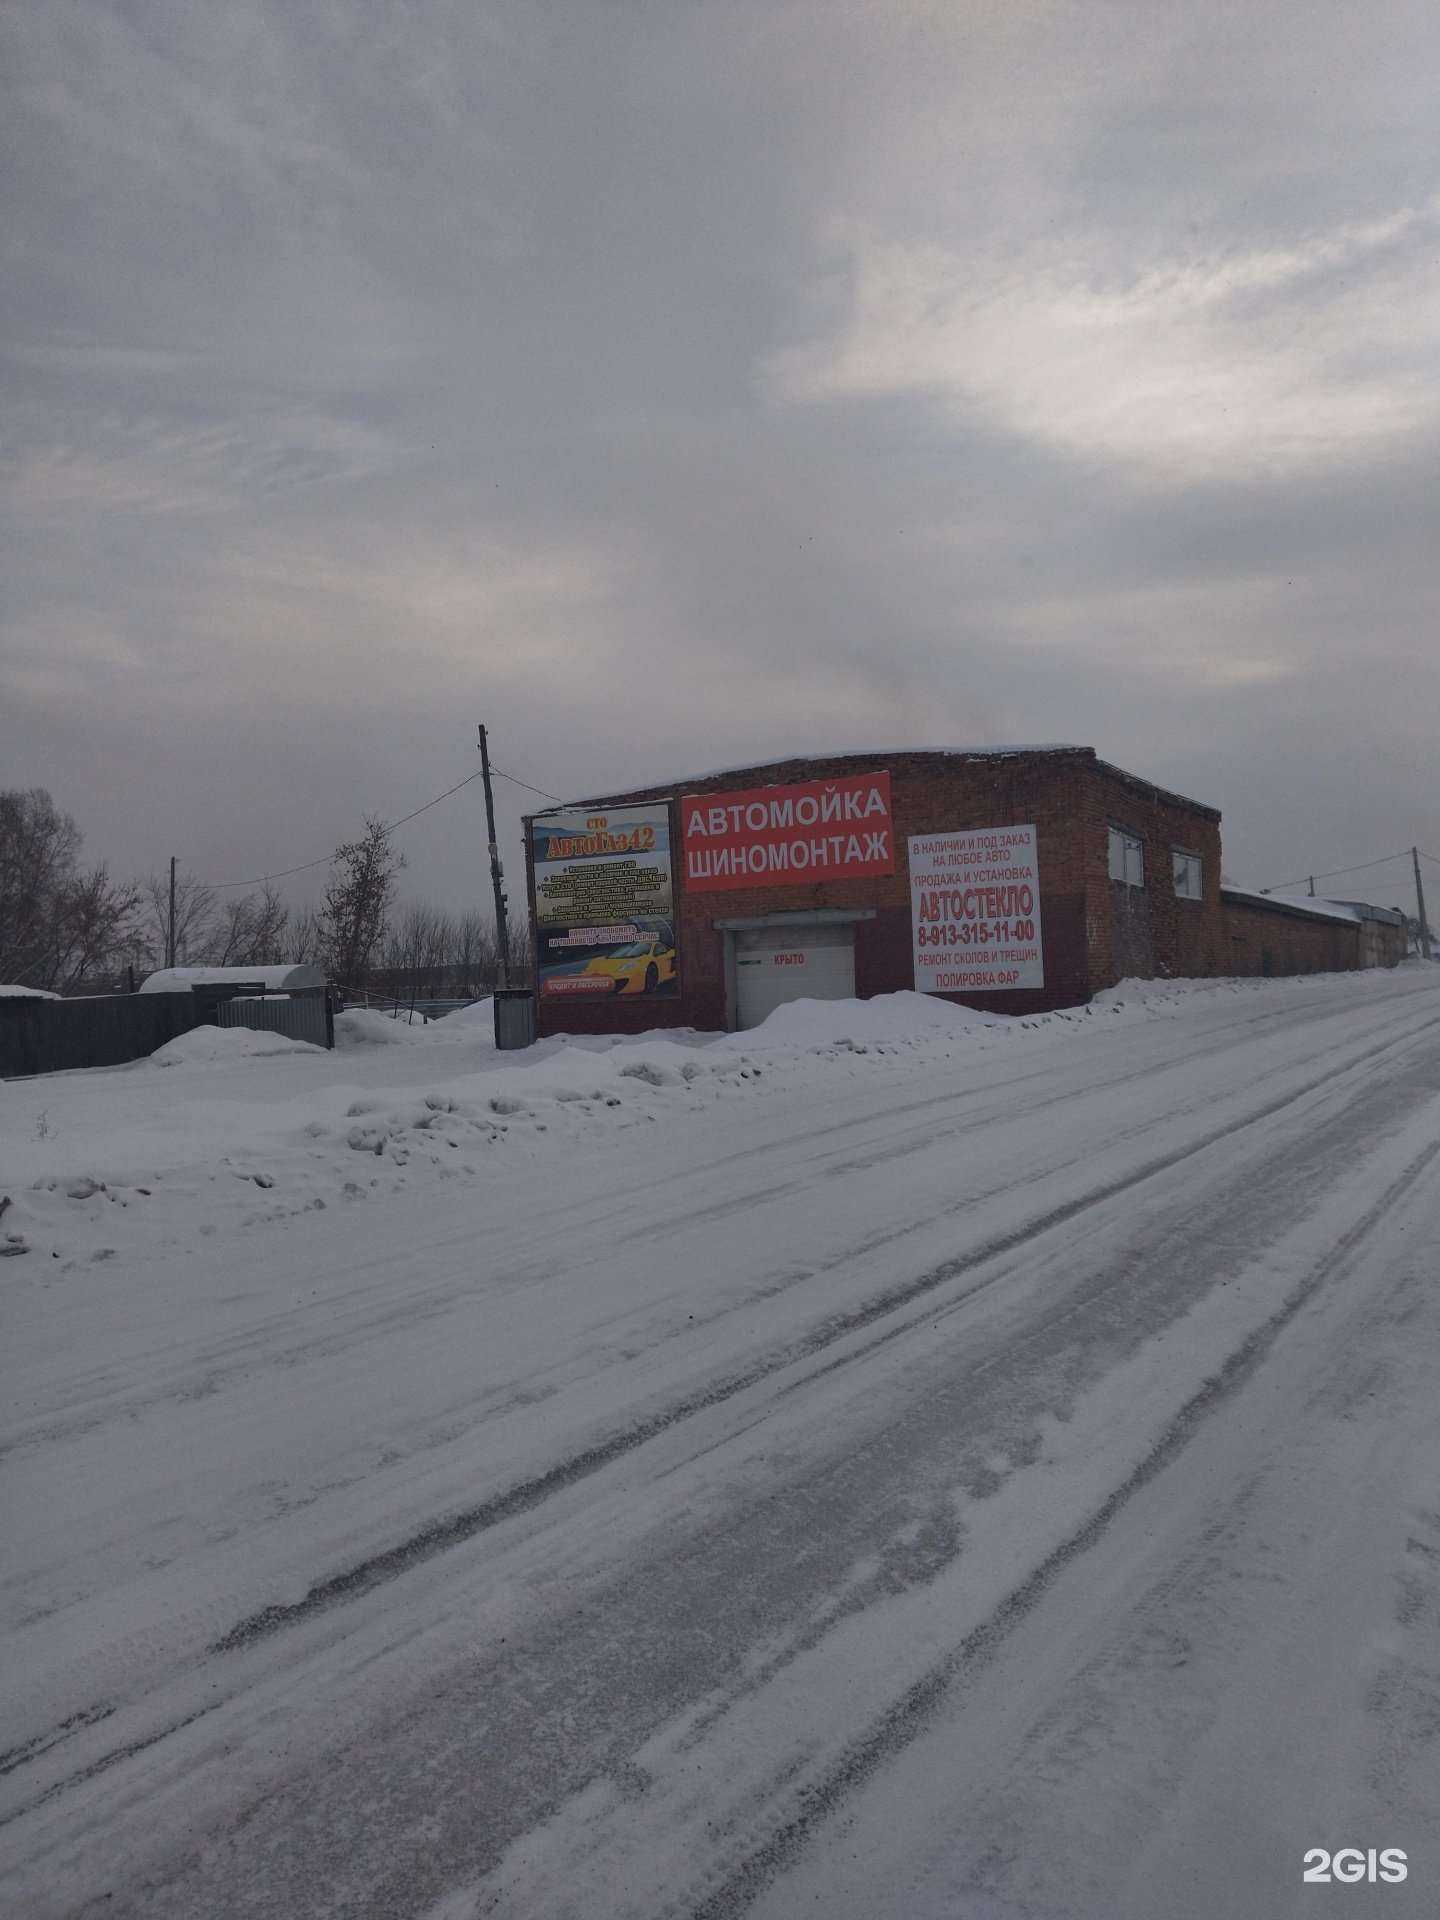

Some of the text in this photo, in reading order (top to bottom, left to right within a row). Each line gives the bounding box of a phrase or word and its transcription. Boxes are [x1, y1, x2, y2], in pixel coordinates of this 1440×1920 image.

[687, 785, 887, 837] АВТОМОЙКА
[586, 816, 608, 829] СТО
[688, 830, 888, 878] ШИНОМОНТАЖ
[913, 833, 1031, 855] В НАЛИЧИИ И ПОД ЗАКАЗ
[932, 849, 1011, 867] НА ЛЮБОЕ АВТО
[914, 866, 1032, 888] ПРОДАЖА И УСТАНОВКА
[919, 884, 1033, 922] АВТОСТЕКЛО
[918, 919, 1035, 947] 8-913-315-11-00
[918, 949, 1038, 967] РЕМОНТ СКОЛОВ И ТРЕЩИН
[936, 970, 1020, 989] ПОЛИРОВКА ФАР
